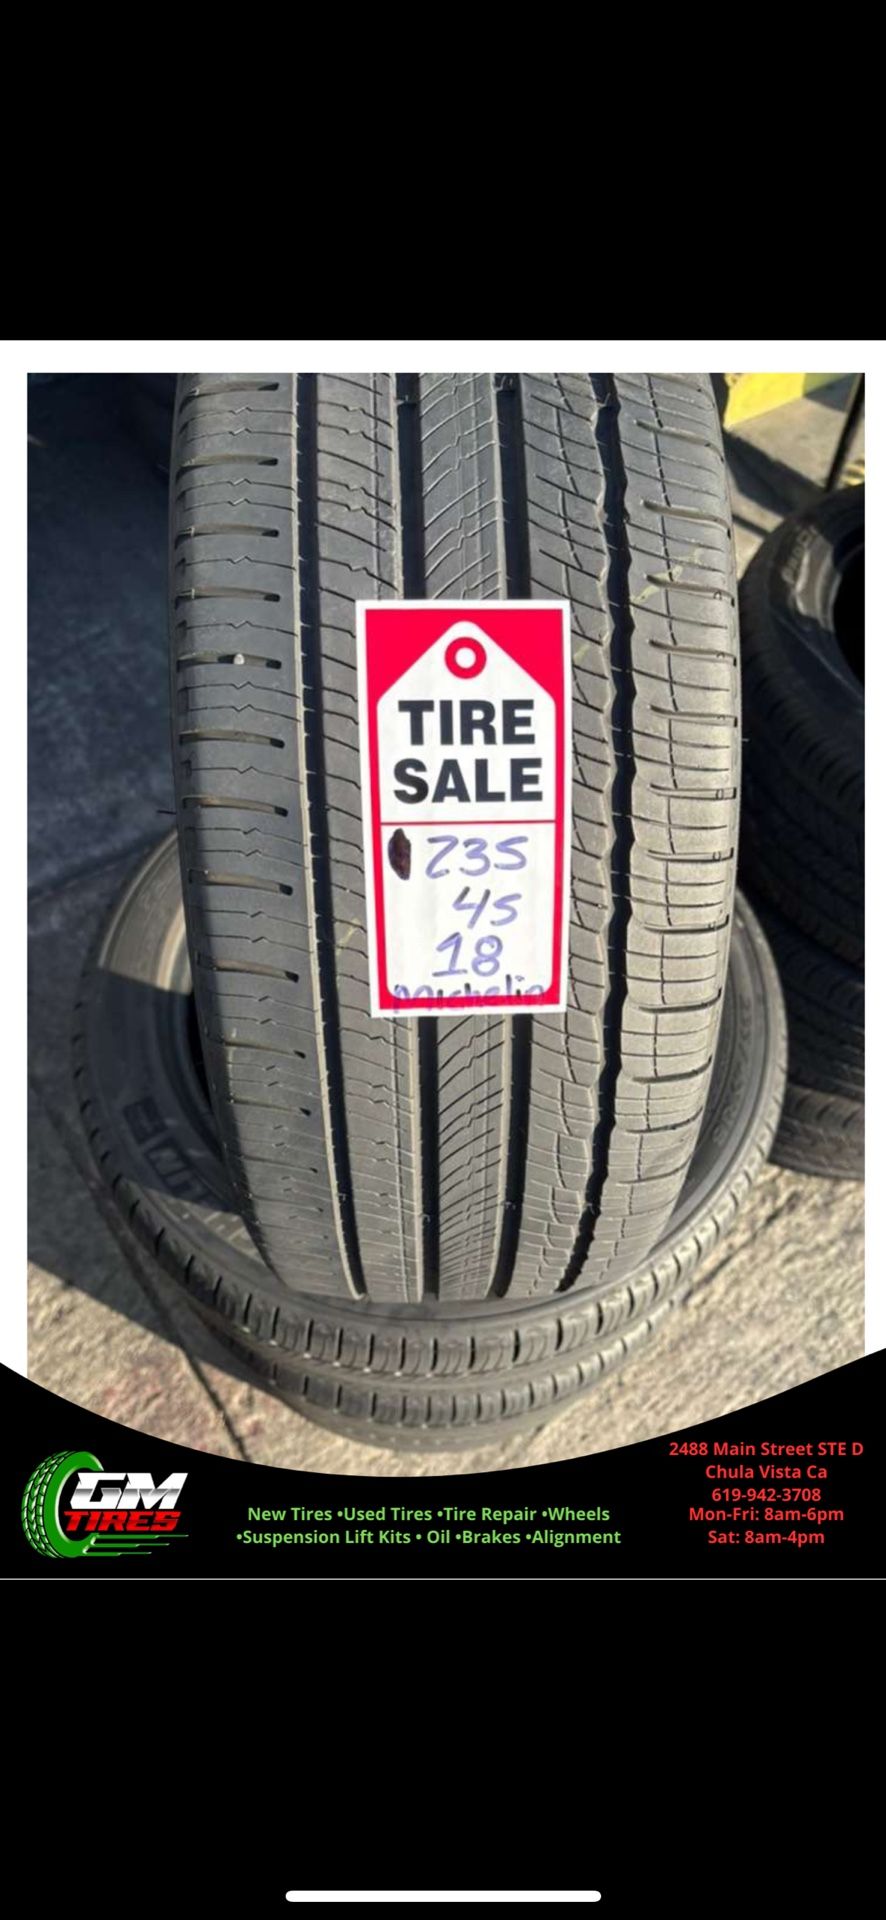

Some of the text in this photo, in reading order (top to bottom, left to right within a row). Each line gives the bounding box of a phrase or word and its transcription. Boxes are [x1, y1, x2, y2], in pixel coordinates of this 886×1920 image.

[398, 700, 535, 745] TIRE
[393, 758, 543, 804] SALE
[425, 836, 528, 878] 235
[452, 886, 522, 929] 45
[432, 932, 503, 976] 18
